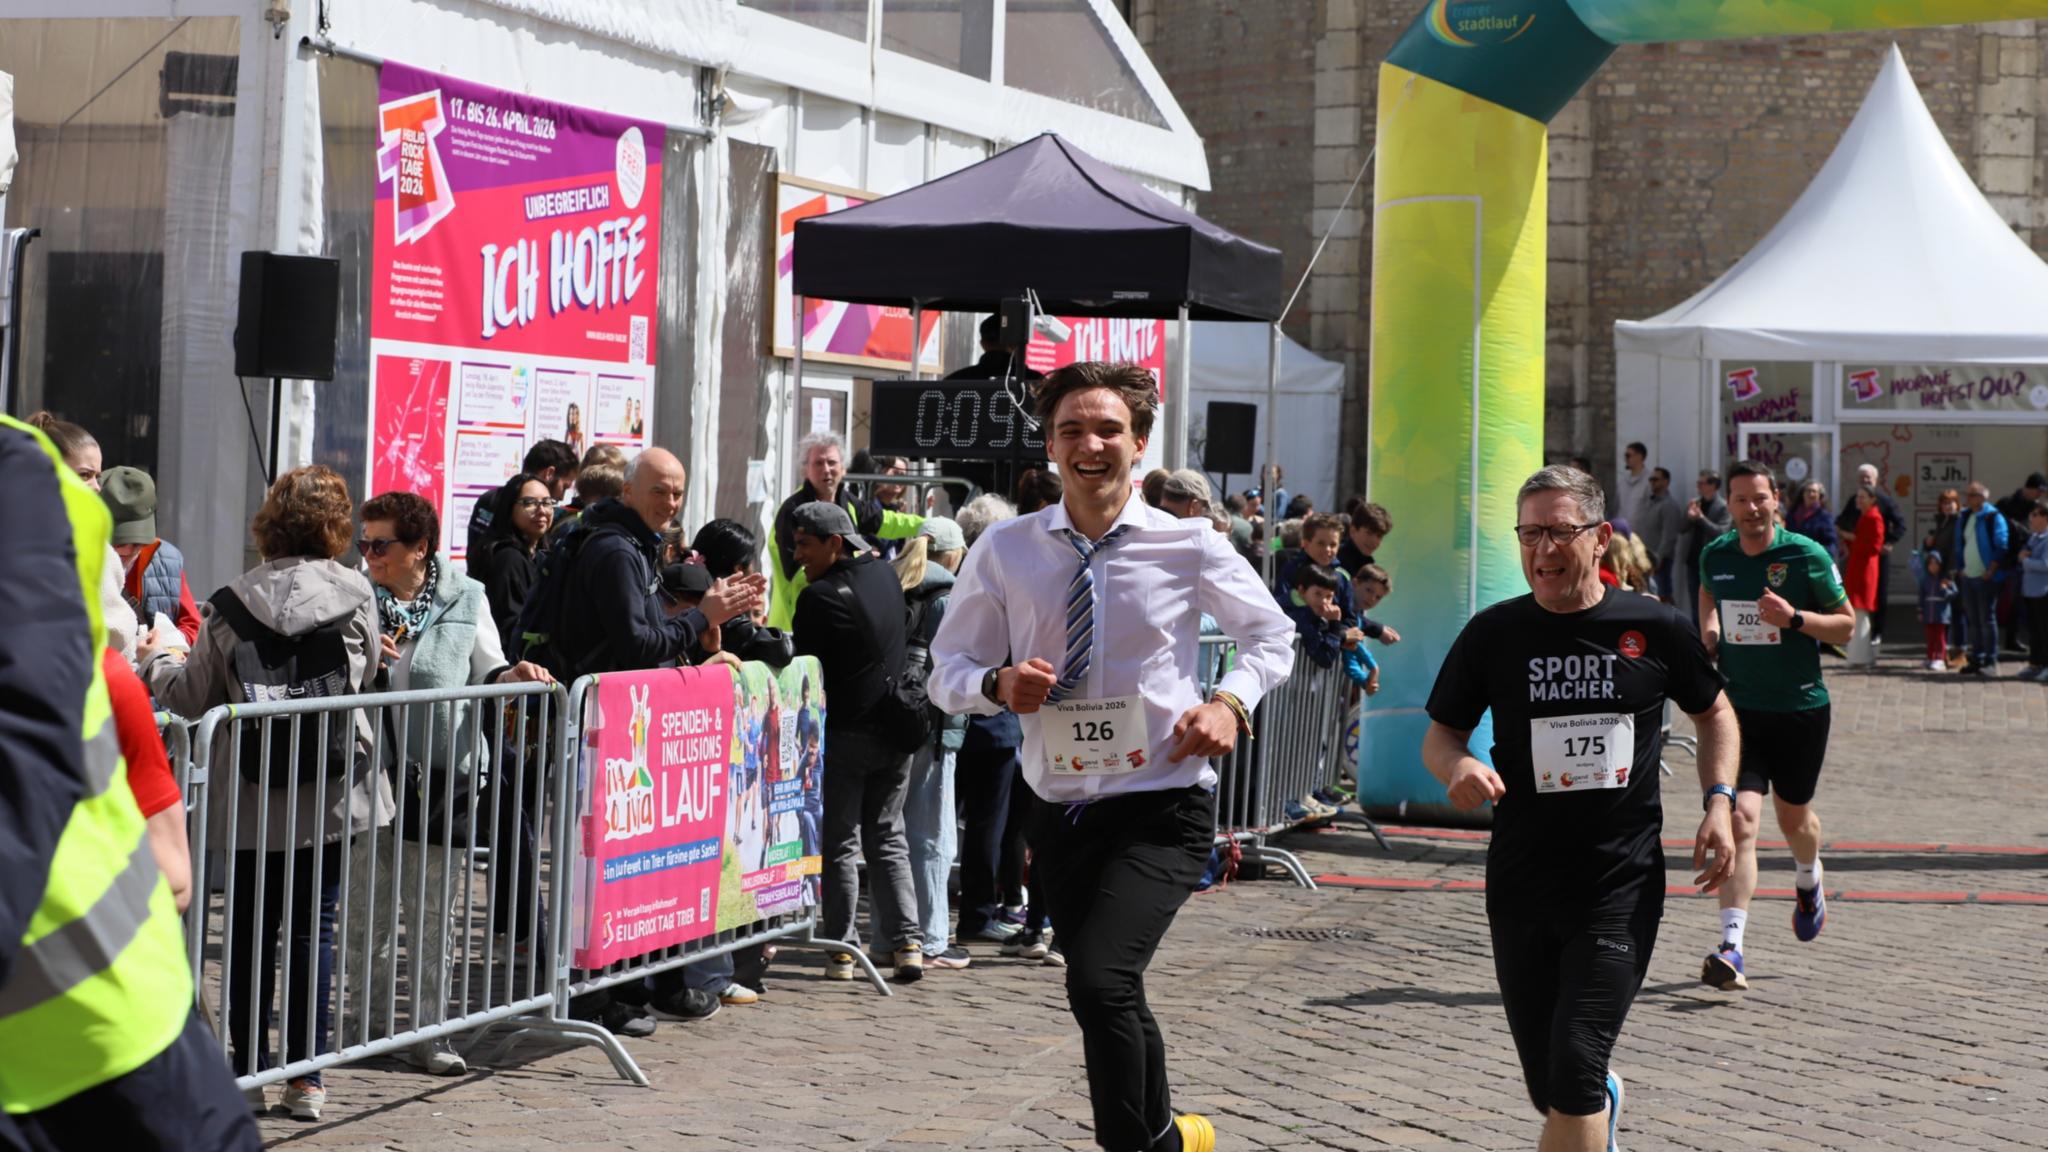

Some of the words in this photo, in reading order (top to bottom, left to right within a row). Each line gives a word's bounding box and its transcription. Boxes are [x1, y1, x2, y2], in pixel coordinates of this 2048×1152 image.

[1458, 14, 1519, 31] stadtlauf
[450, 97, 465, 120] 17.
[467, 101, 485, 125] BIS
[485, 105, 501, 128] 26.
[502, 109, 533, 135] APRIL
[533, 116, 557, 140] 2026
[401, 141, 425, 160] ROCK
[400, 157, 425, 178] TAGE
[400, 175, 424, 196] 2026
[525, 185, 610, 220] UNBEGREIFLICH
[481, 237, 540, 339] ICH
[550, 214, 648, 318] HOFFE
[1890, 369, 1952, 397] WORAUF
[1920, 382, 1976, 408] HOFFST
[1978, 370, 2026, 401] DU?
[1732, 386, 1799, 425] WORAUF
[1922, 466, 1937, 481] 3.
[1940, 466, 1967, 481] Jh.
[1737, 614, 1761, 626] 202
[1528, 654, 1618, 682] SPORT
[1529, 680, 1622, 702] MACHER.
[1057, 704, 1074, 712] Viva
[1075, 703, 1103, 712] Bolivia
[1105, 701, 1126, 710] 2026
[661, 708, 713, 738] SPENDEN-
[714, 706, 722, 731] &
[1072, 720, 1114, 741] 126
[1550, 720, 1568, 729] Viva
[1569, 718, 1598, 728] Bolivia
[1599, 717, 1620, 726] 2026
[661, 735, 722, 767] INKLUSIONS
[1564, 736, 1606, 758] 175
[661, 763, 722, 828] LAUF
[643, 856, 651, 871] in
